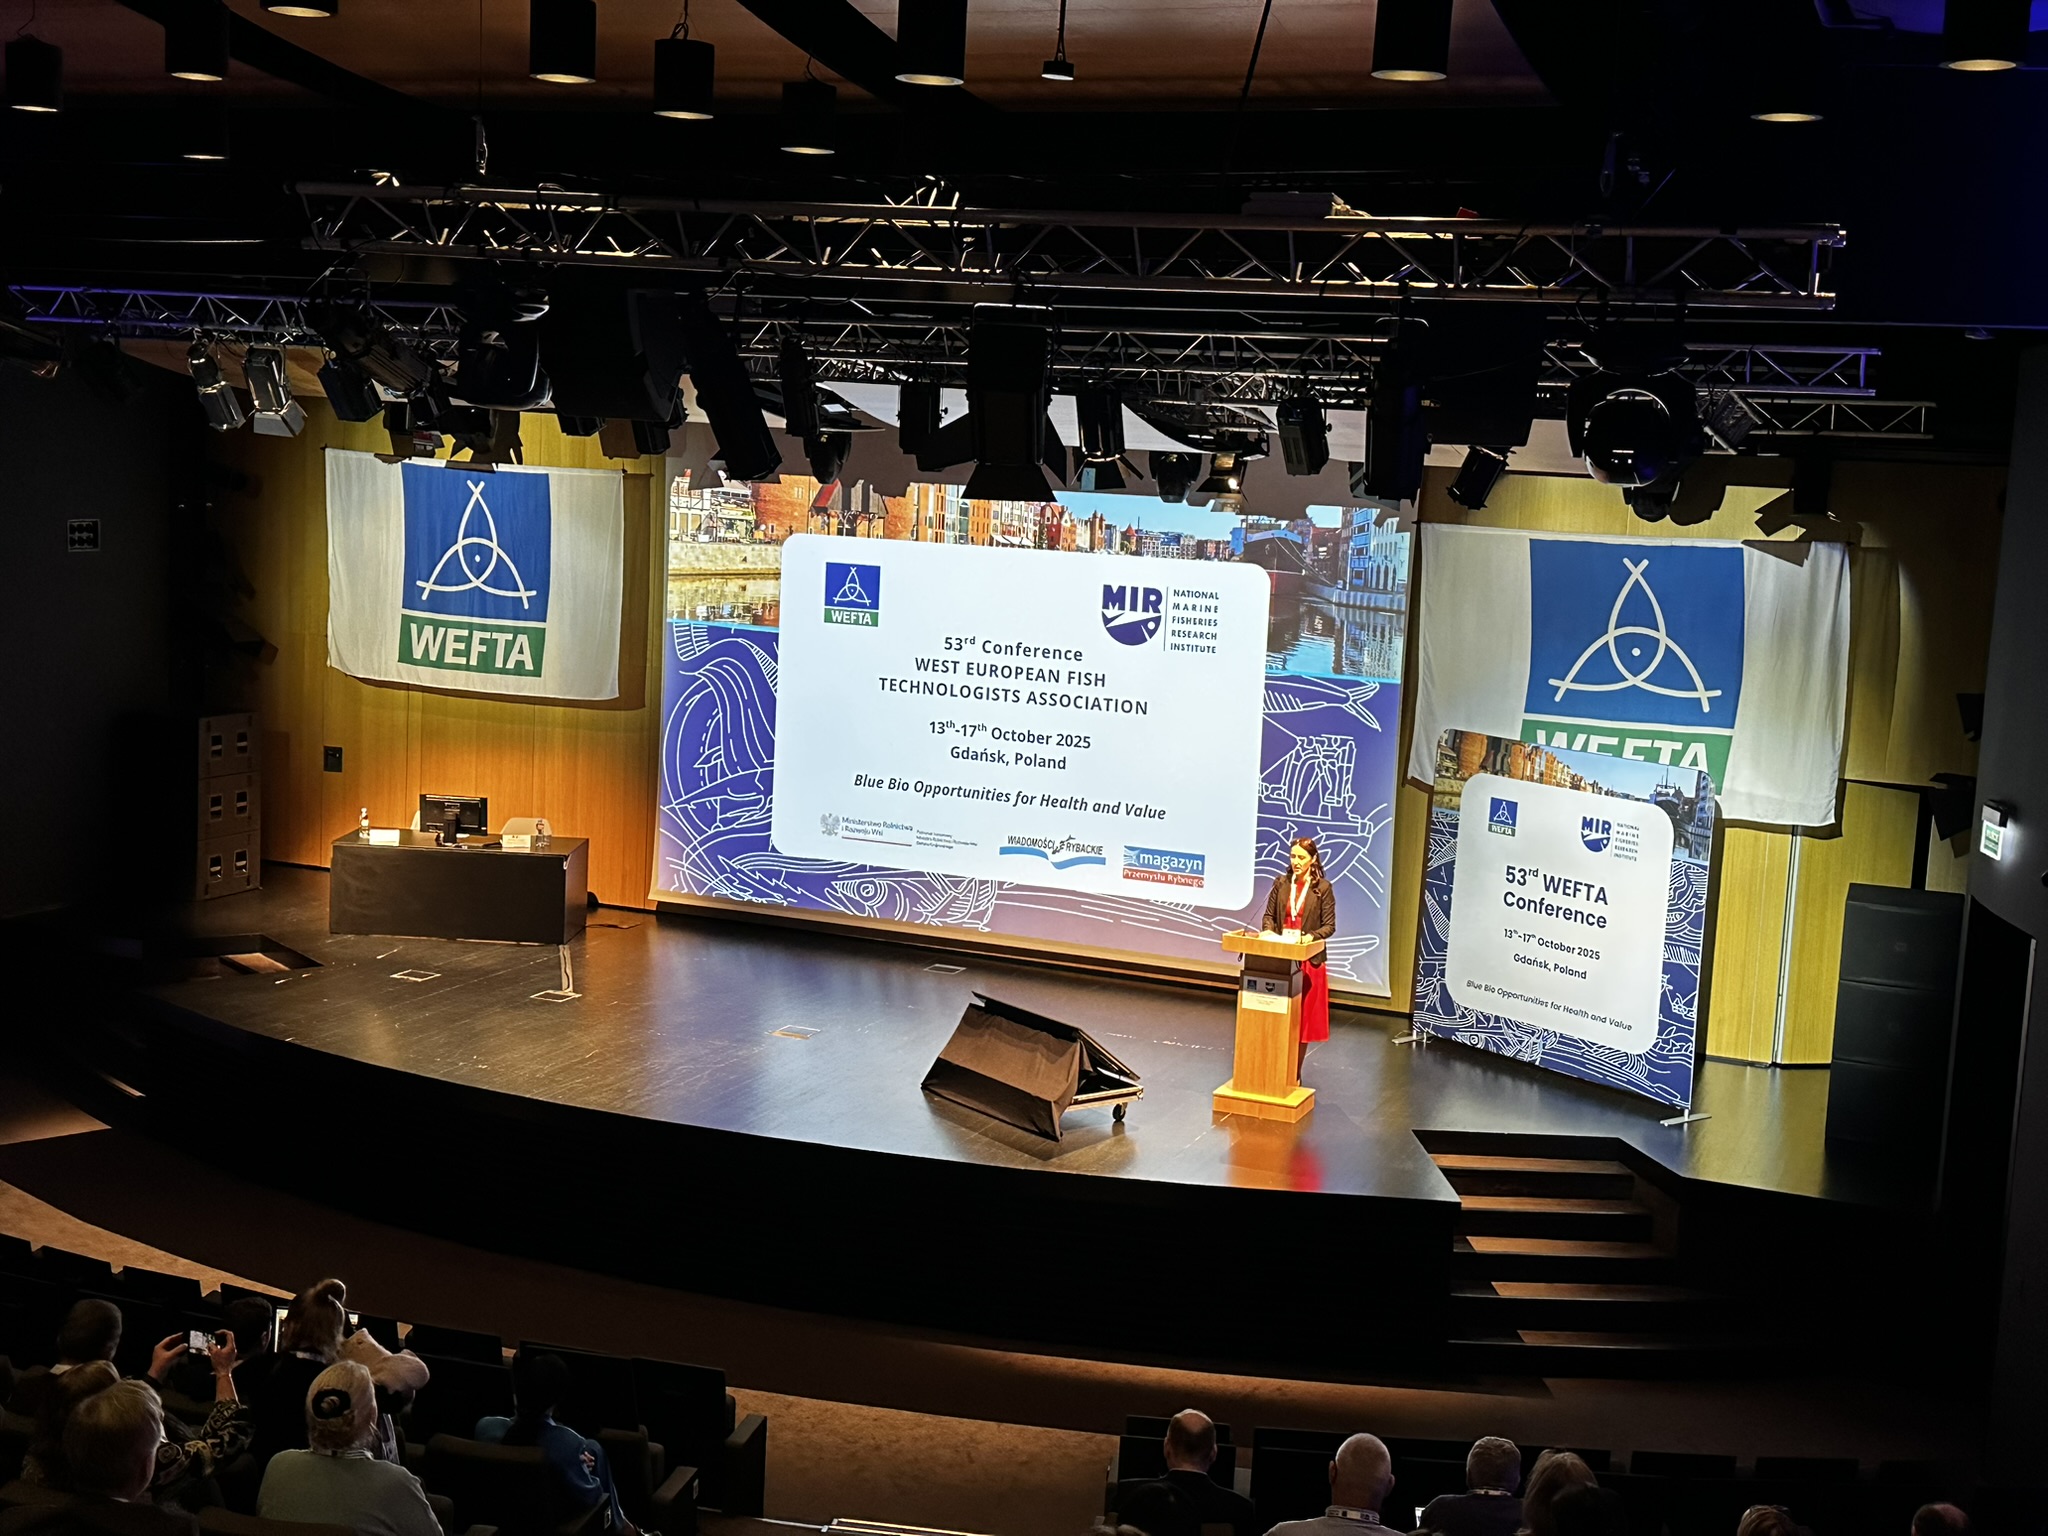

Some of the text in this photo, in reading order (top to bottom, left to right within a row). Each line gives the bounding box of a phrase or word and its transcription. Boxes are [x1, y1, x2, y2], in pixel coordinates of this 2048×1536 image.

[1102, 584, 1163, 614] MIR
[1173, 589, 1220, 600] NATIONAL
[831, 610, 872, 625] WEFTA
[1172, 602, 1219, 613] MARINE
[1171, 615, 1218, 627] FISHERIES
[410, 622, 534, 671] WEFTA
[1171, 629, 1218, 641] RESEARCH
[944, 636, 1083, 662] 53rd Conference
[1170, 642, 1217, 654] INSTITUTE
[915, 657, 1106, 687] WEST EUROPEAN FISH
[879, 677, 1148, 715] TECHNOLOGISTS ASSOCIATION
[929, 720, 1091, 749] 13th-17th October 2025
[950, 745, 1067, 770] Gdańsk, Poland
[854, 774, 1166, 820] Blue Bio Opportunities for Health and Value
[1581, 816, 1612, 836] MIR
[1007, 835, 1103, 855] WIADOMOŚCI RYBACKIE
[1139, 854, 1203, 871] magazyn
[1167, 874, 1204, 888] Rybnego
[1505, 865, 1608, 906] 53rd WEFTA
[1503, 891, 1607, 929] Conference
[1537, 937, 1576, 954] October
[1577, 946, 1601, 960] 2025
[1513, 953, 1587, 979] Gdańsk, Poland
[1466, 979, 1633, 1031] Blue Bio Opportunities for Health and Value
